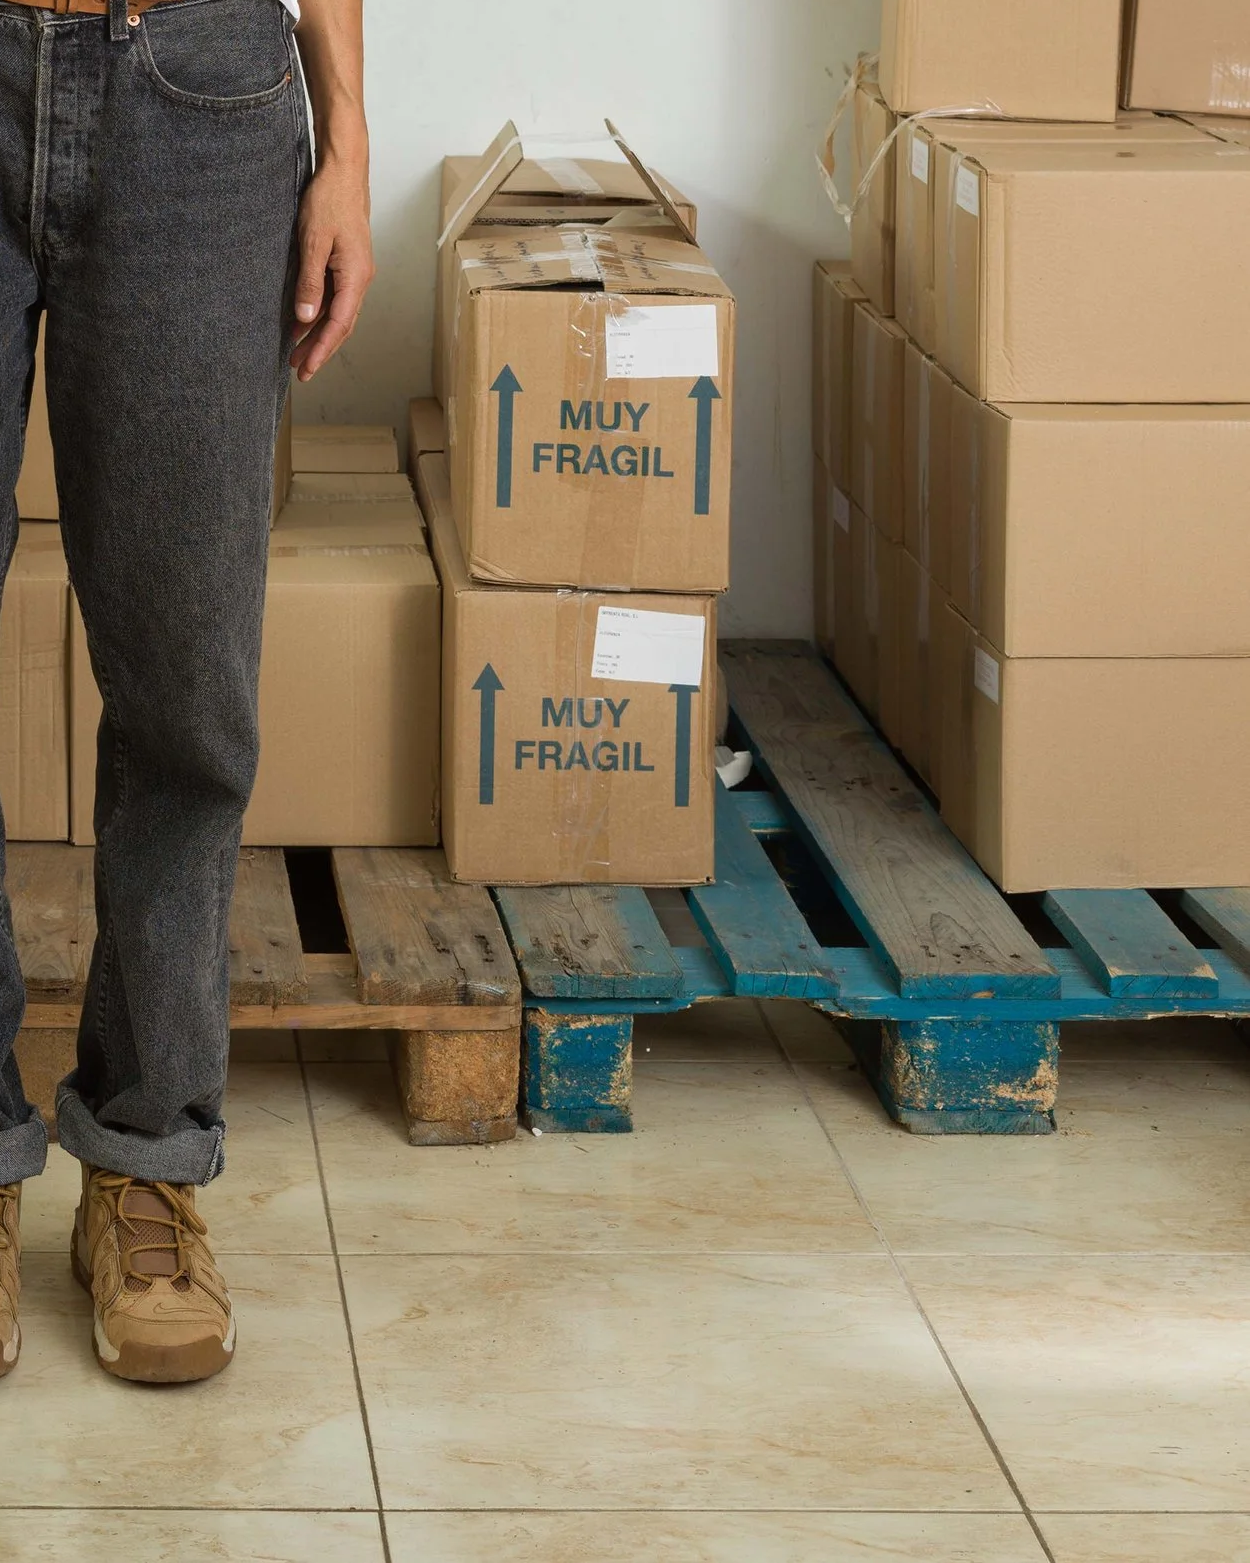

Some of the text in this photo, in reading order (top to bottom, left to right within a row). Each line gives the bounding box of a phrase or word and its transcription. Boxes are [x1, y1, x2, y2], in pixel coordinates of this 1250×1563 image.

[560, 400, 650, 432] MUY
[532, 443, 674, 478] FRAGIL
[541, 697, 630, 728] MUY
[514, 740, 655, 772] FRAGIL
